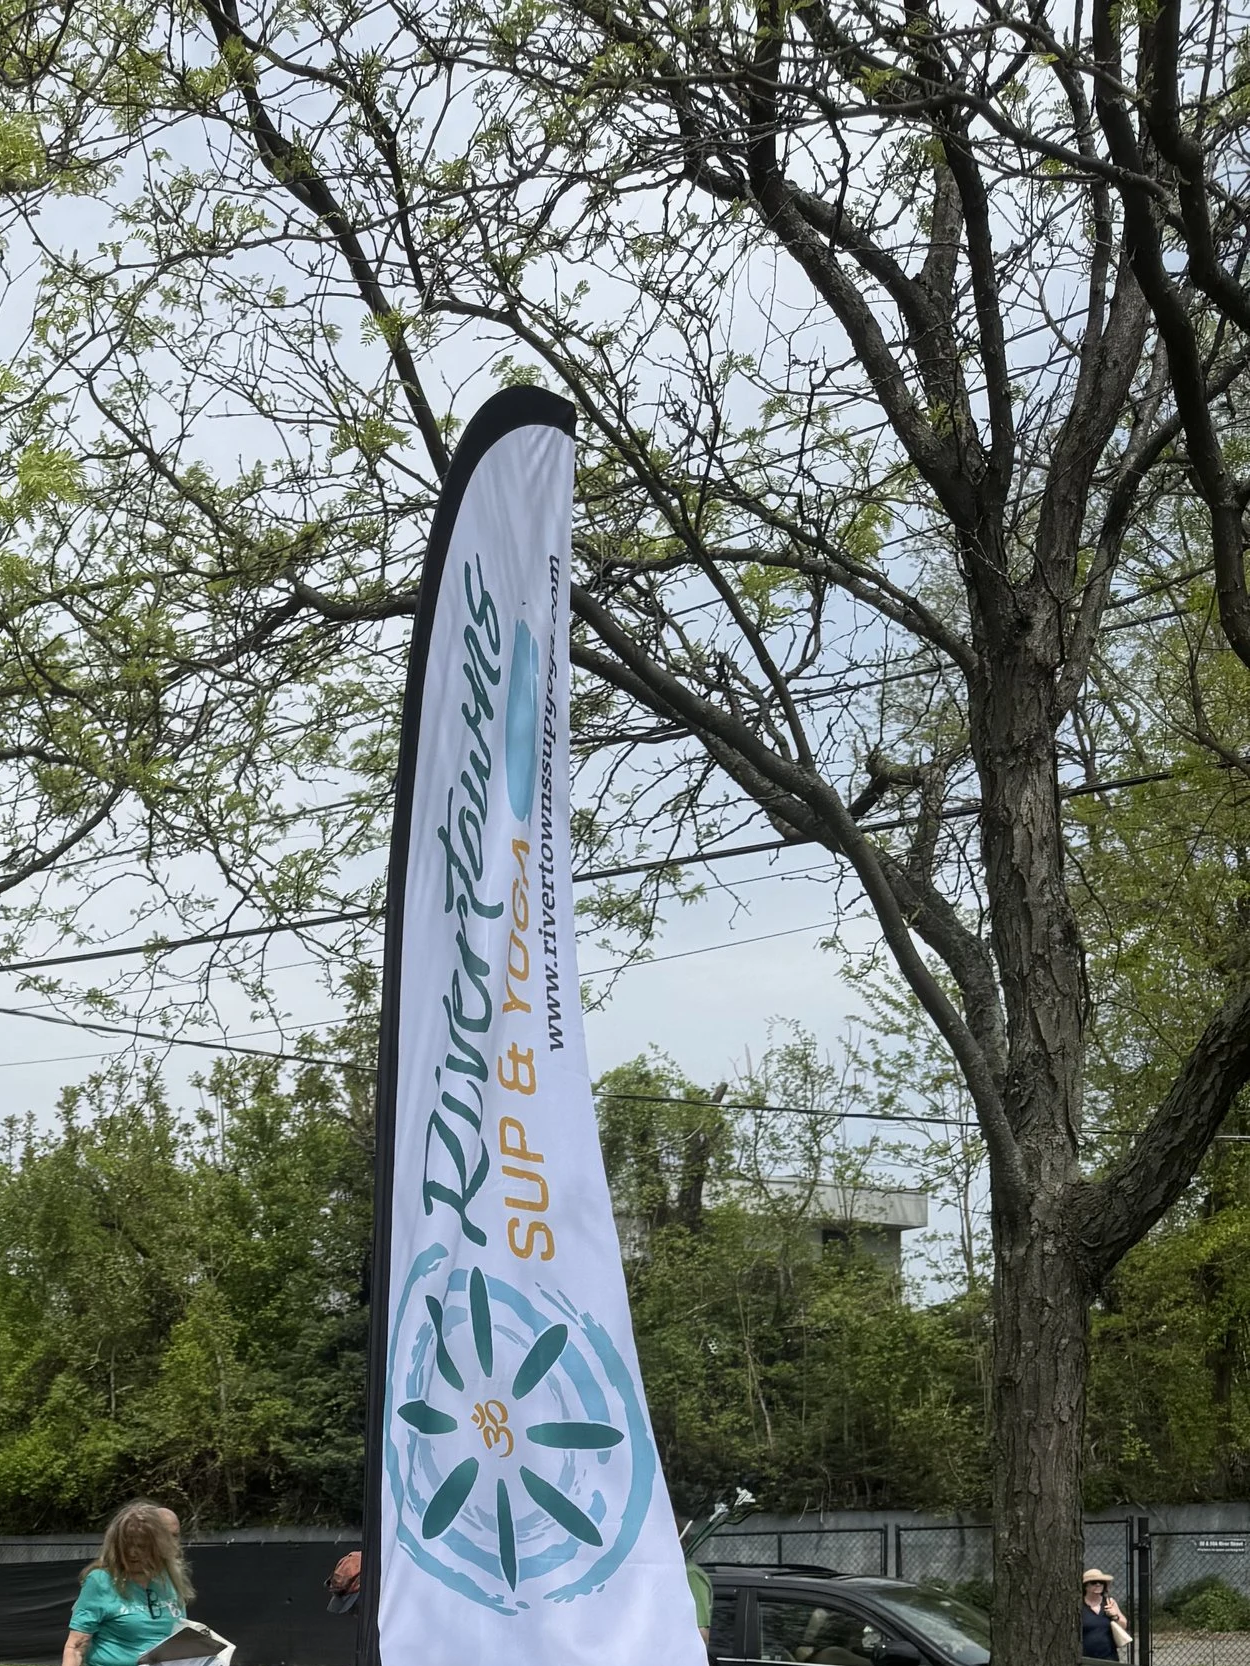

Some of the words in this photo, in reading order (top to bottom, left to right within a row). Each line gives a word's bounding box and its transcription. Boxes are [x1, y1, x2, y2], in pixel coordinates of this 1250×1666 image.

[423, 553, 504, 1247] Rivertowns
[503, 838, 531, 1014] YOGA
[498, 1042, 537, 1095] &
[499, 1116, 555, 1260] SUP
